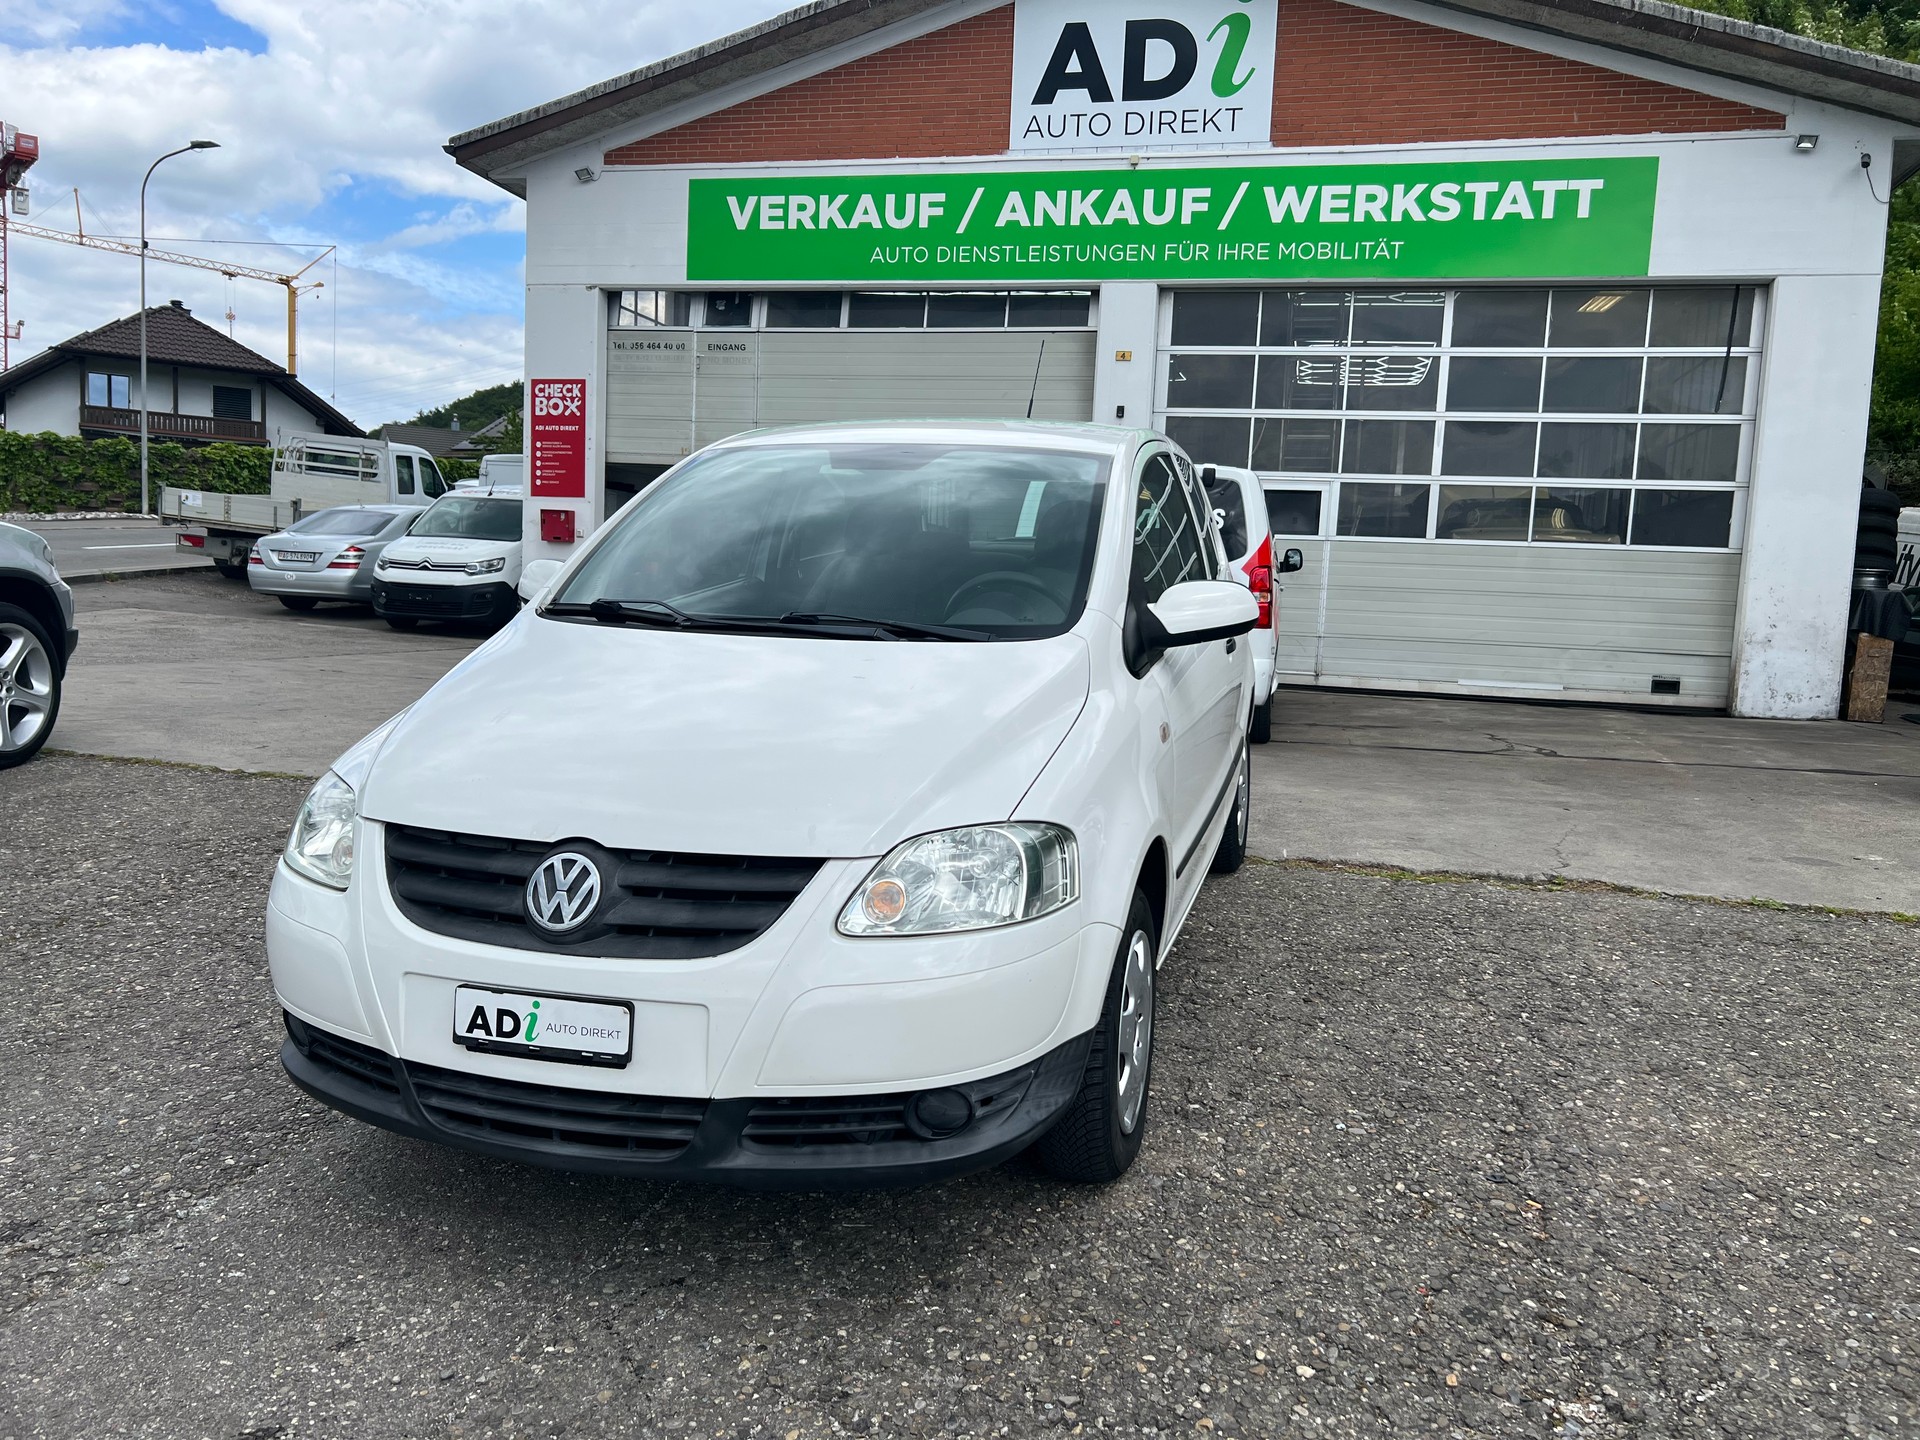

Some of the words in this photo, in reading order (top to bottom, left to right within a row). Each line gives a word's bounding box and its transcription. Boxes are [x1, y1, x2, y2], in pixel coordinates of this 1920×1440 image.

[1031, 0, 1256, 106] ADi
[1023, 112, 1111, 139] AUTO
[1125, 107, 1244, 136] DIREKT
[726, 192, 946, 230] VERKAUF
[955, 187, 985, 234] /
[994, 187, 1212, 228] ANKAUF
[1217, 181, 1250, 230] /
[1262, 178, 1604, 223] WERKSTATT
[870, 246, 929, 263] AUTO
[937, 244, 1155, 263] DIENSTLEISTUNGEN
[1165, 240, 1209, 261] FÜR
[1217, 242, 1270, 260] IHRE
[1278, 237, 1405, 260] MOBILITÄT
[646, 342, 661, 350] 464
[663, 342, 673, 350] 40
[676, 342, 686, 350] 00
[707, 343, 746, 352] EINGANG
[534, 383, 582, 398] CHECK
[534, 397, 582, 416] BOX
[465, 1000, 540, 1042] ADi
[546, 1022, 578, 1035] AUTO
[580, 1026, 622, 1040] DIREKT
